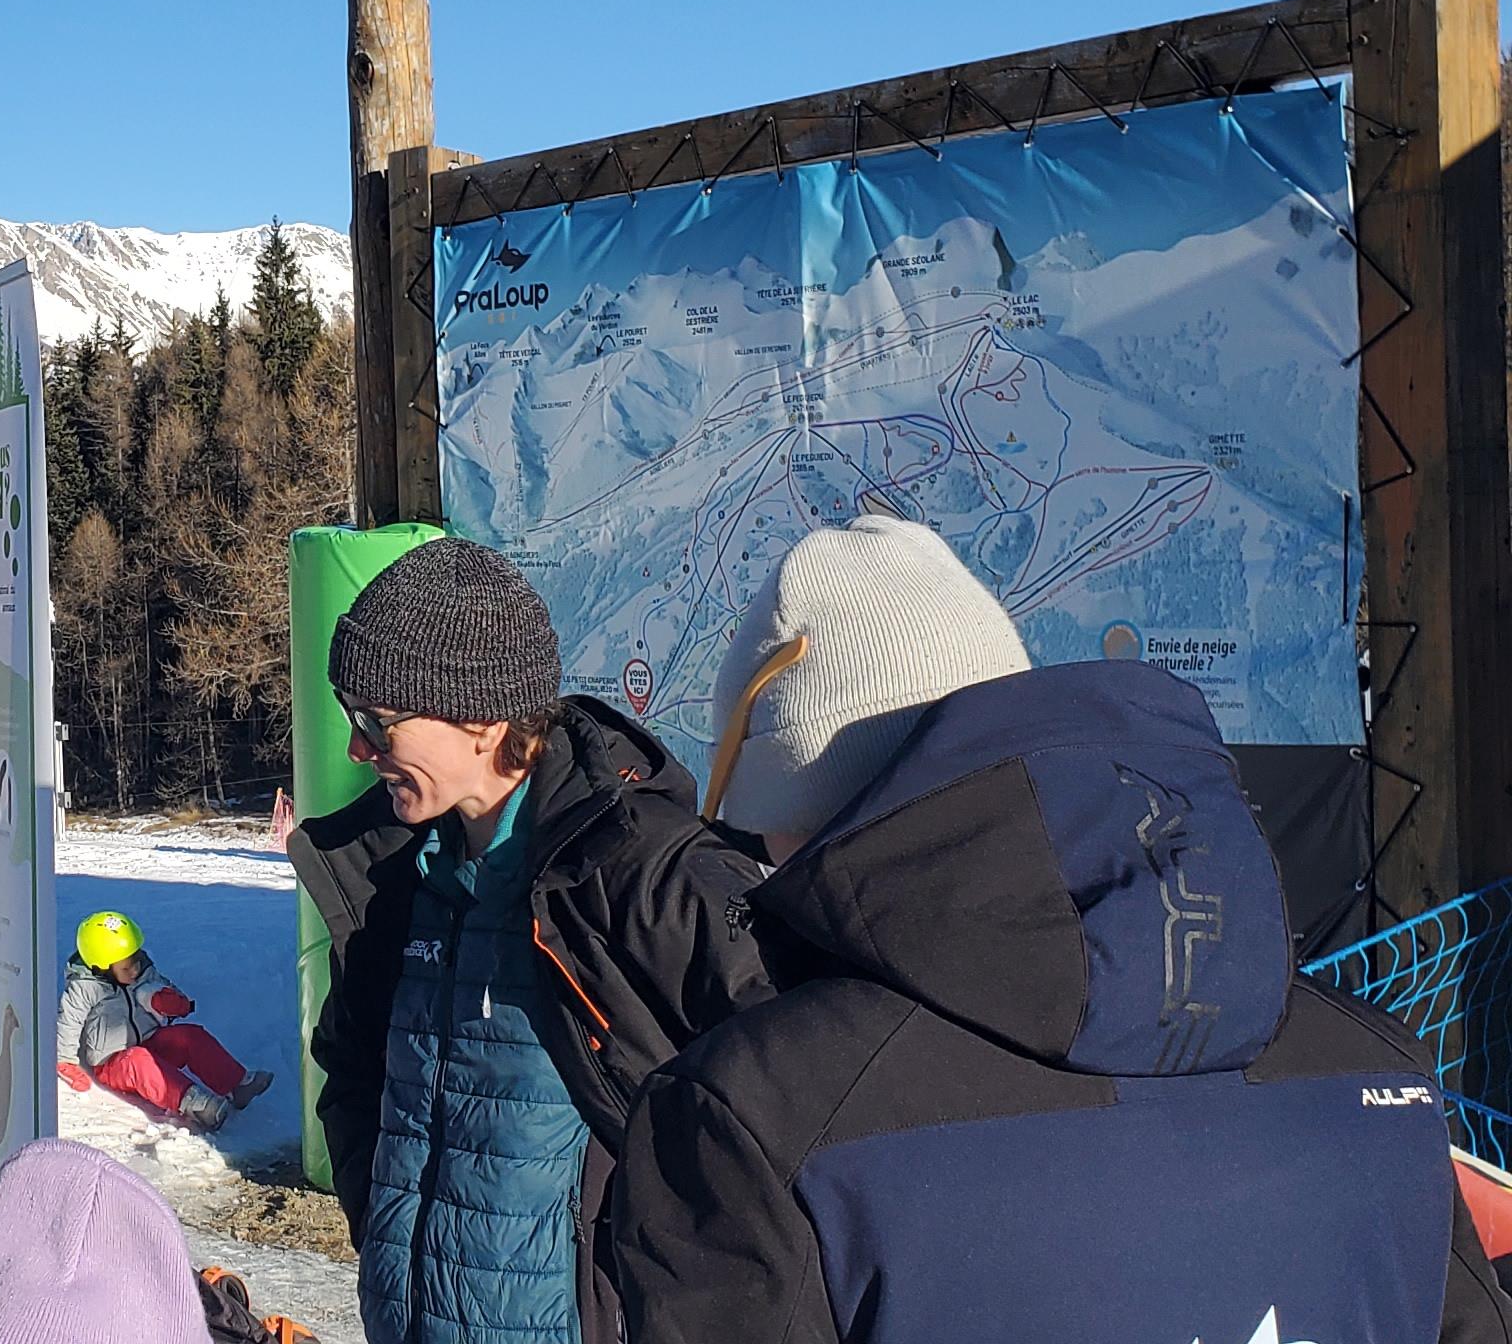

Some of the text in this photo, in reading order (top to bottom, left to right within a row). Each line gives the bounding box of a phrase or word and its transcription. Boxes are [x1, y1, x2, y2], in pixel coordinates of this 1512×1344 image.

[454, 281, 549, 318] PraLoup
[1012, 295, 1039, 305] LE LAC
[709, 306, 718, 314] LA
[1148, 637, 1237, 658] Envie de neige
[1149, 655, 1214, 672] naturelle ?
[629, 669, 648, 678] VOUS
[629, 678, 647, 687] ÊTES
[633, 687, 644, 695] ICI
